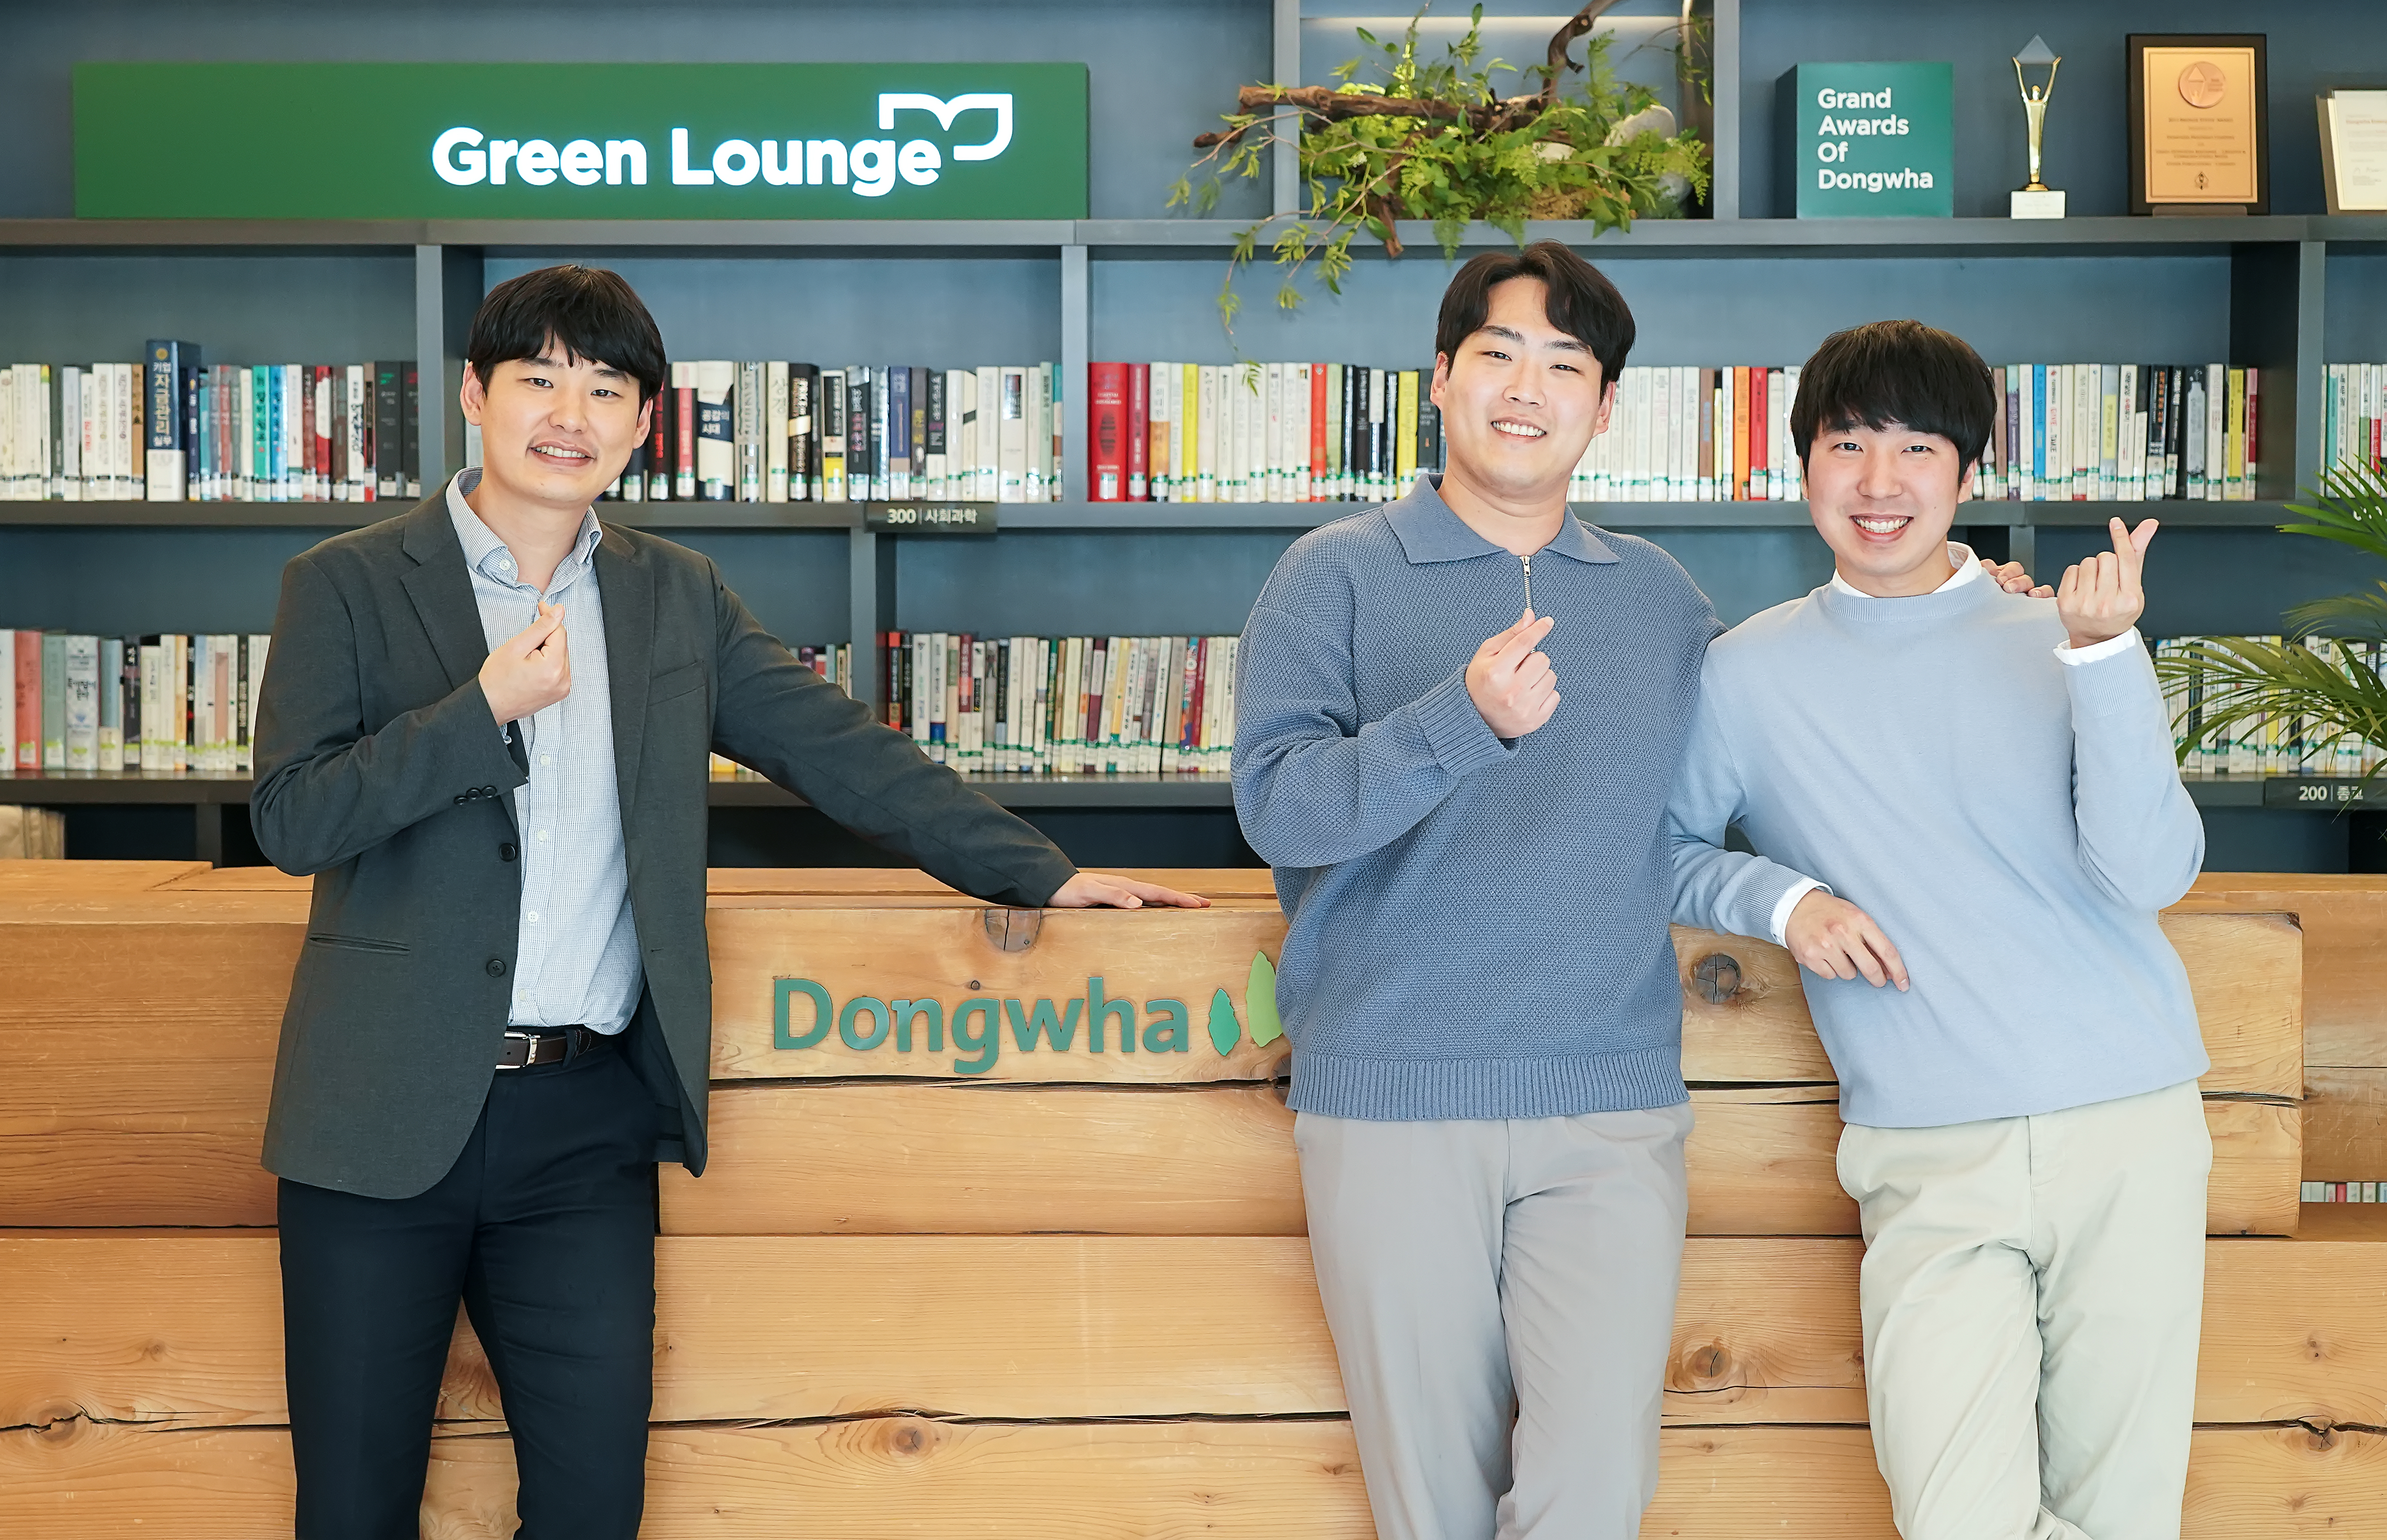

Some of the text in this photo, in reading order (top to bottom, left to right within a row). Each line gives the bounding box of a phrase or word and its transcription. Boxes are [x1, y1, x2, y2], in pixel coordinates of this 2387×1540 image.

[1817, 87, 1892, 109] Grand
[1818, 114, 1909, 136] Awards
[432, 127, 941, 197] Green Lounge
[1817, 141, 1848, 163] Of
[1818, 167, 1934, 193] Dongwha
[887, 508, 978, 524] 300 사회과학
[2299, 786, 2328, 801] 200
[774, 977, 1189, 1074] Dongwha
